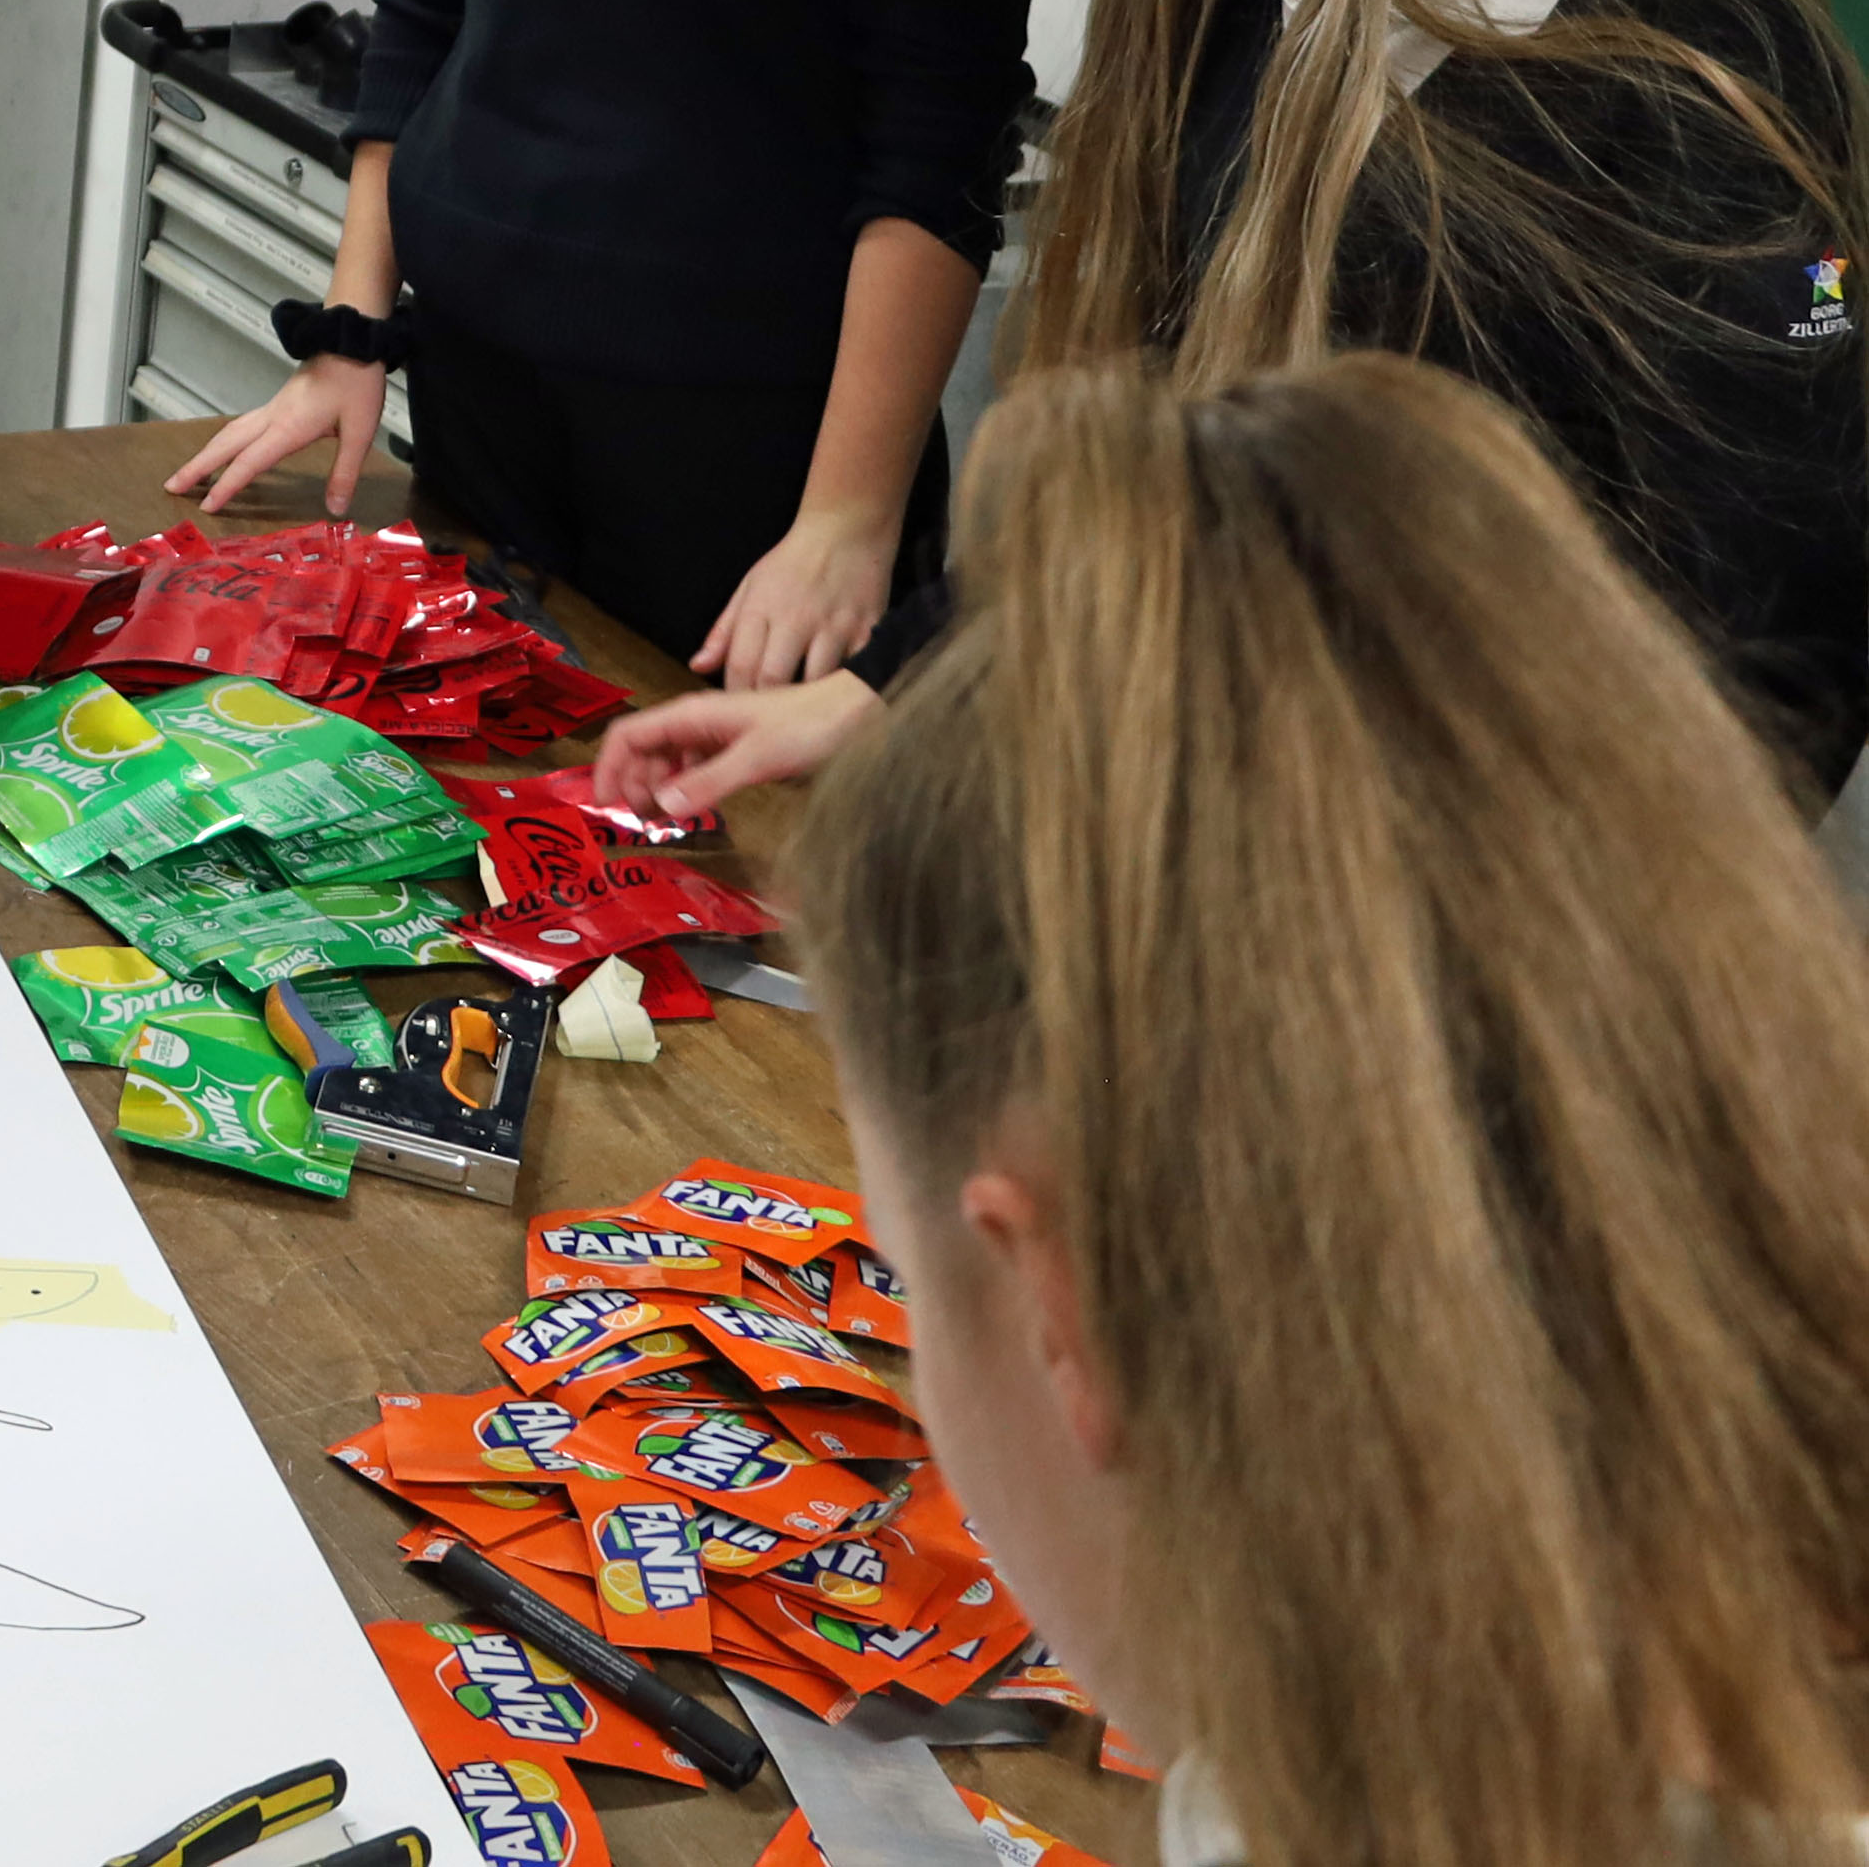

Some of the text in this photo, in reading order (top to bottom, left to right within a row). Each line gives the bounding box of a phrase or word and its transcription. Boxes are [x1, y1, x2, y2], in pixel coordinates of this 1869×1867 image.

[167, 712, 278, 748] Sprite
[10, 741, 108, 792] Sprite
[351, 755, 415, 787] Sprite
[181, 865, 251, 898] Sprite
[265, 948, 321, 979] Sprite
[99, 979, 207, 1025] Sprite
[192, 1084, 263, 1156] Sprite
[661, 1180, 816, 1229] FANTA
[542, 1229, 708, 1259] FANTA
[504, 1289, 639, 1365] FANTA
[699, 1304, 861, 1365] FANTA
[647, 1420, 773, 1491] FANTA
[618, 1503, 705, 1611] FANTA
[455, 1633, 578, 1744] FANTA
[180, 1798, 234, 1834] STANLEY
[451, 1761, 545, 1867] ANTA
